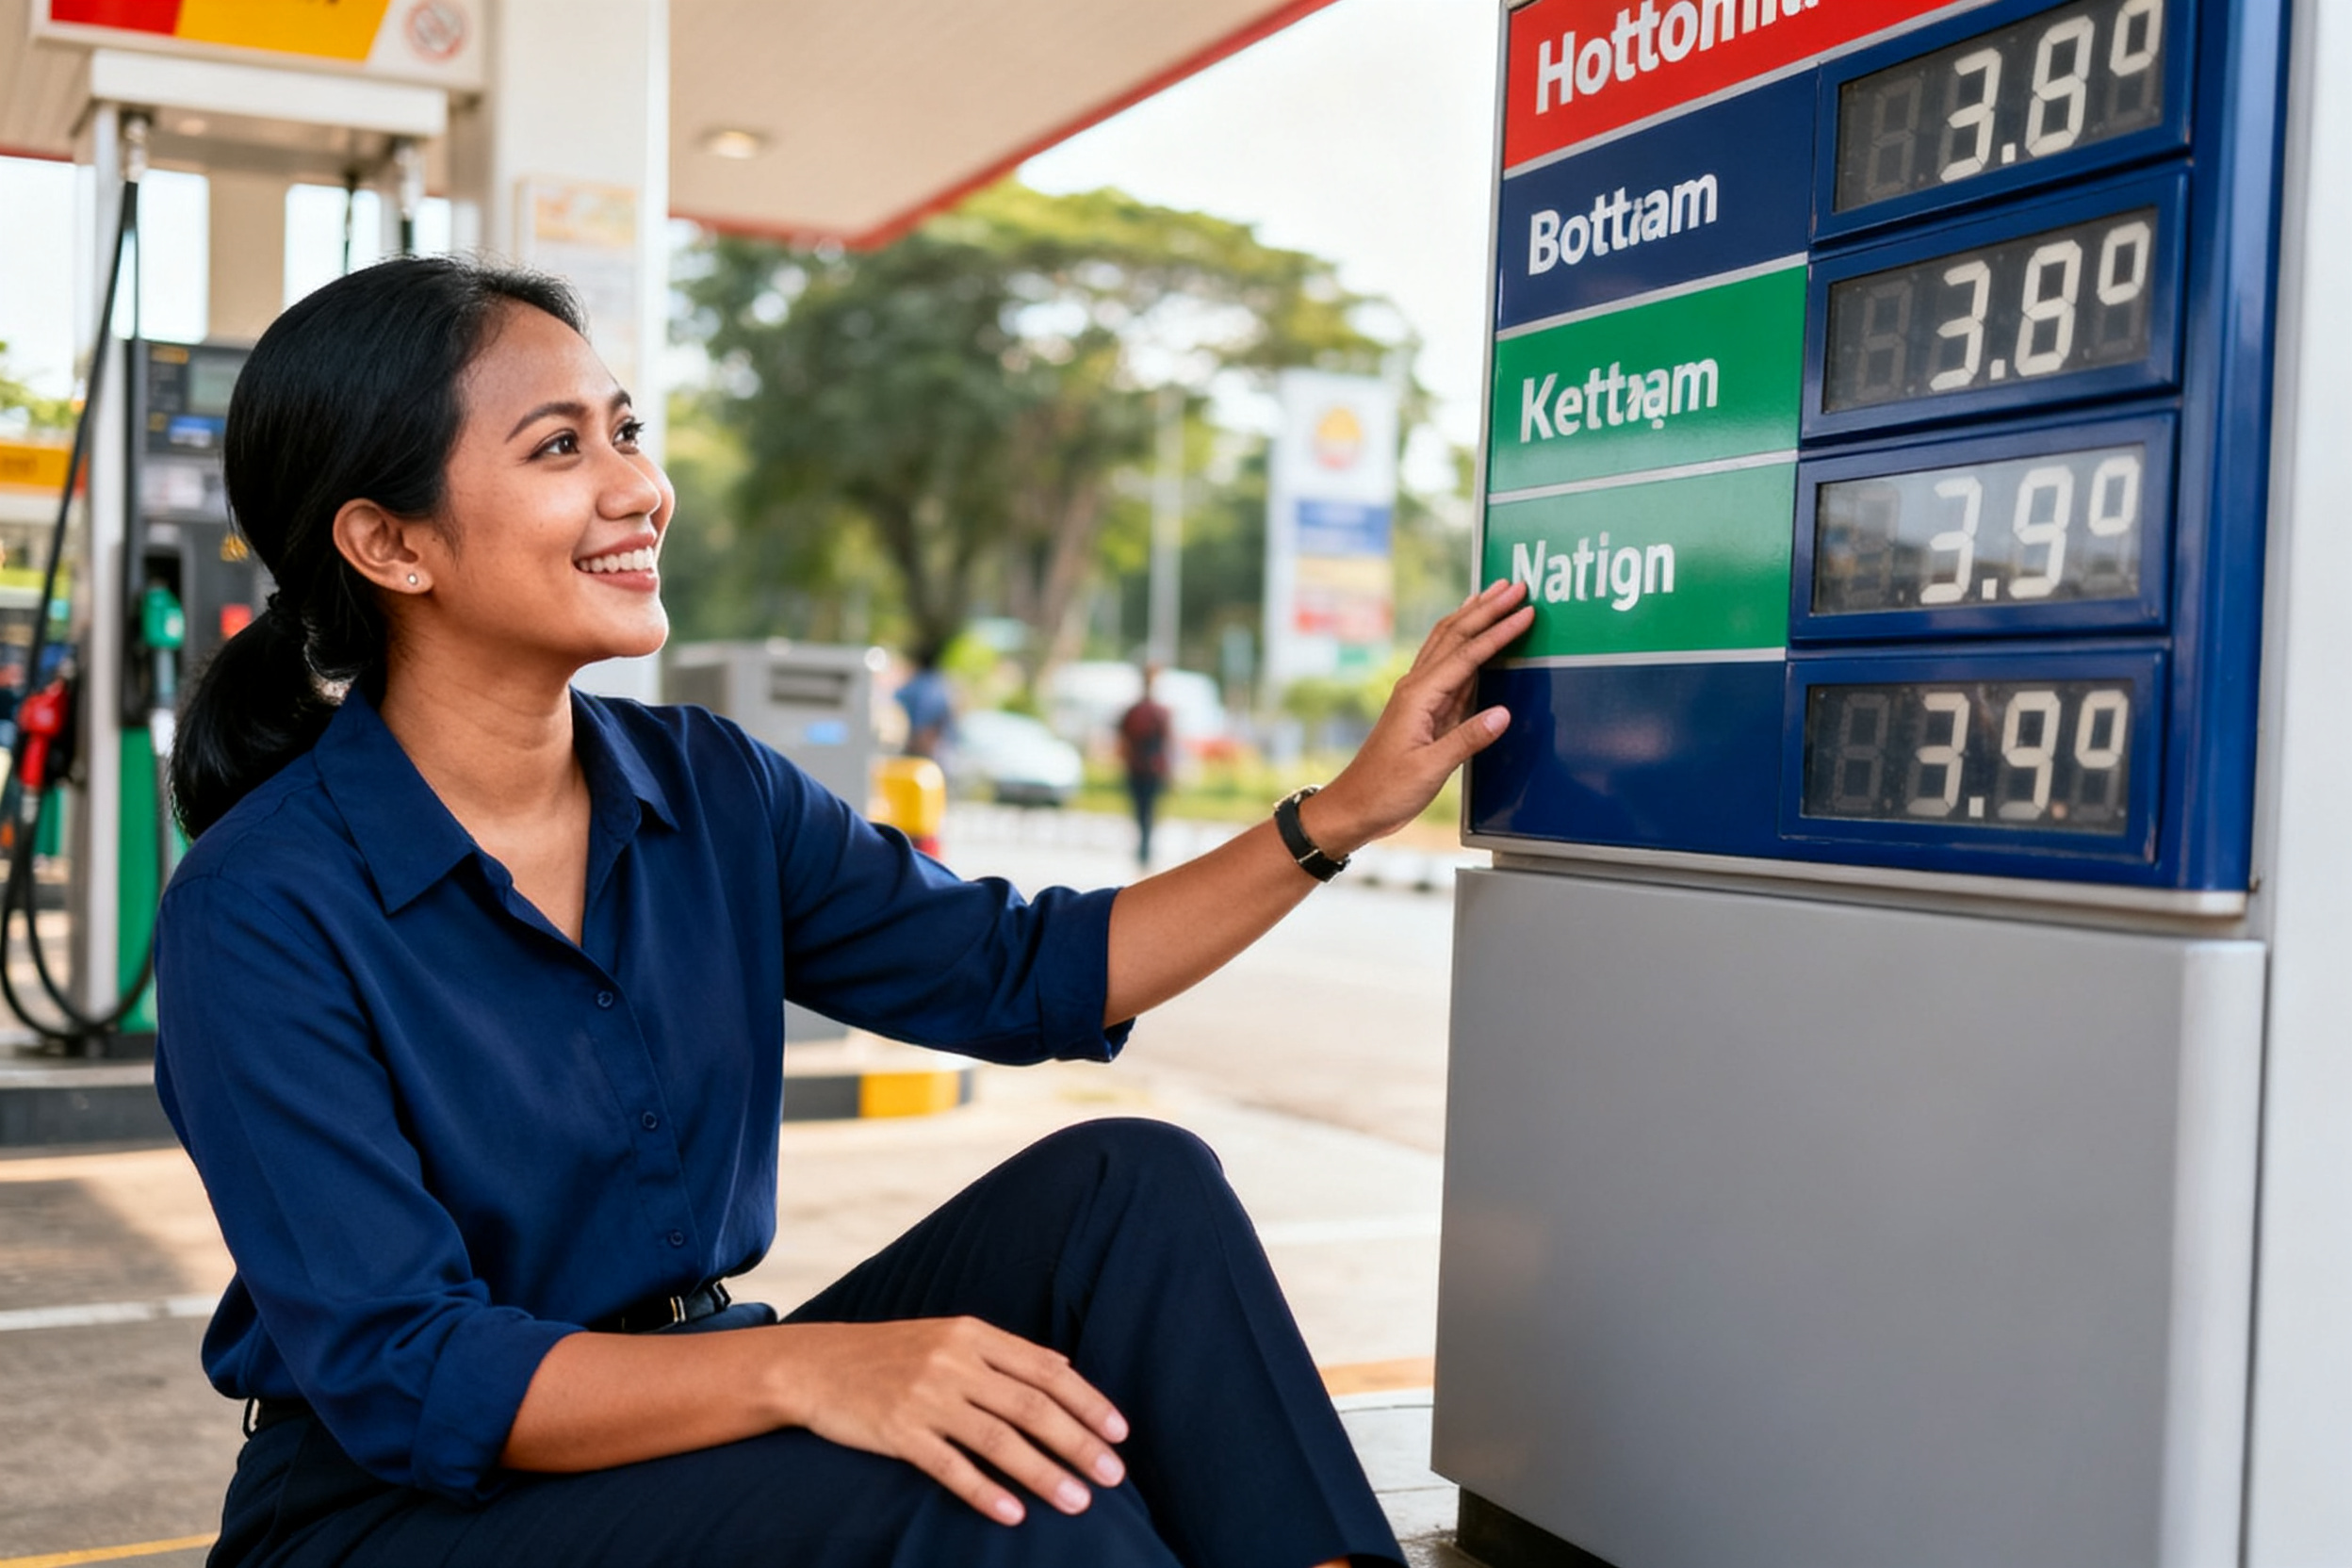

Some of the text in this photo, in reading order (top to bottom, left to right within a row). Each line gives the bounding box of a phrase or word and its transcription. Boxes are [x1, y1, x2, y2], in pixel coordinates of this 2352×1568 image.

[1929, 220, 2151, 392] 3.80
[1511, 531, 1675, 612] Natign
[1919, 455, 2142, 605] 3.90
